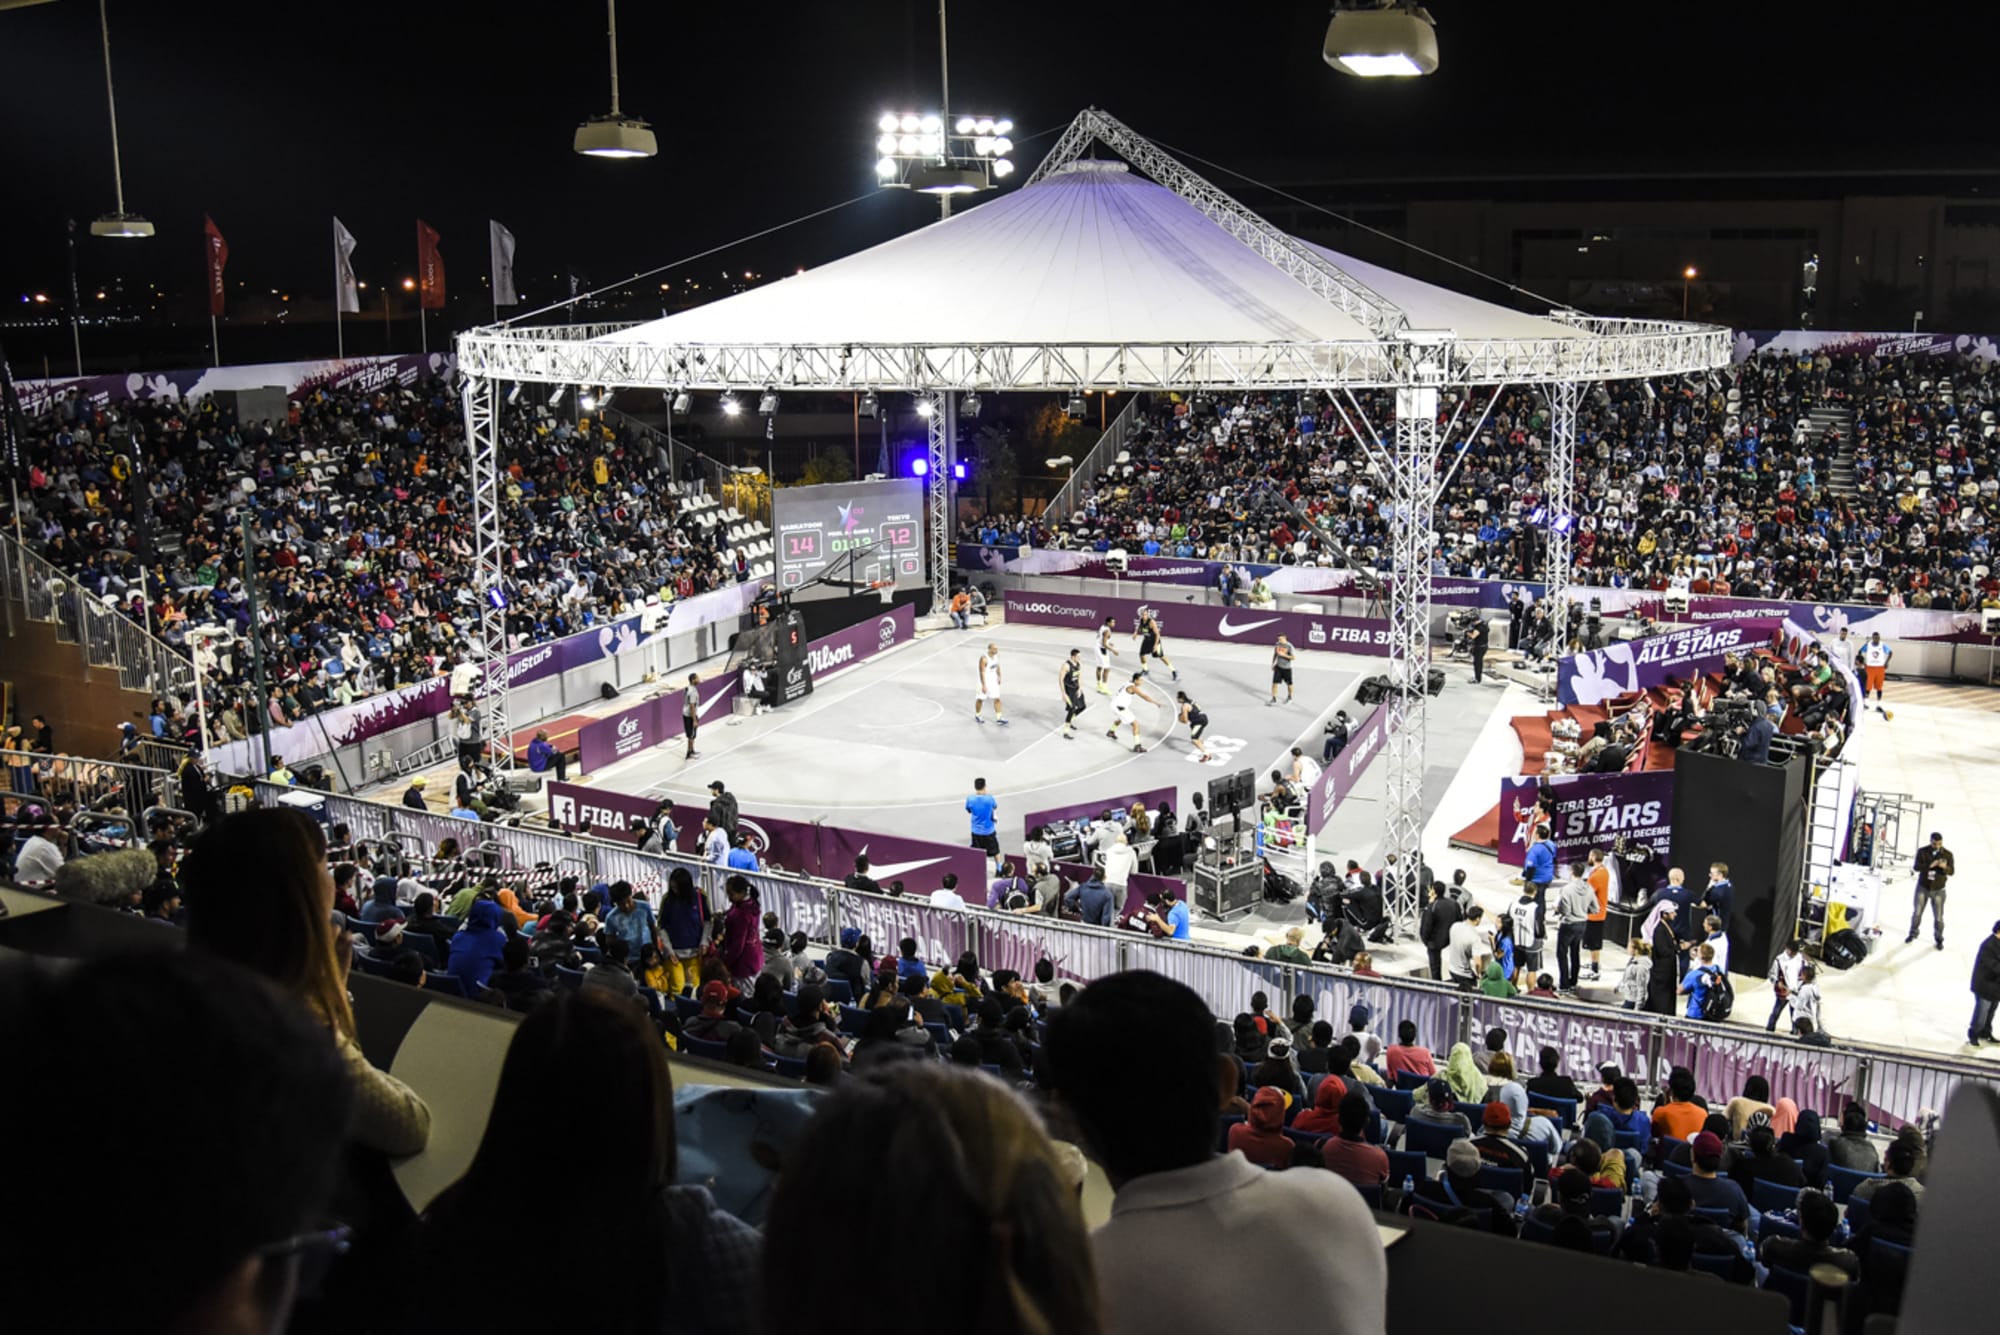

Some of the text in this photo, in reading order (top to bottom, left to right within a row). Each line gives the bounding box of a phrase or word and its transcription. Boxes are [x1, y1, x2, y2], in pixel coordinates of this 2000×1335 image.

[1896, 336, 1933, 353] STARS
[359, 362, 398, 389] STARS
[790, 535, 815, 555] 14
[888, 527, 911, 545] 12
[1007, 600, 1097, 619] The LOOK Company
[1331, 627, 1371, 644] FIBA
[1668, 631, 1691, 643] FIBA
[1636, 628, 1742, 665] ALL STARS
[1587, 794, 1614, 810] 3x3
[580, 804, 625, 831] FIBA
[1566, 800, 1661, 836] STARS
